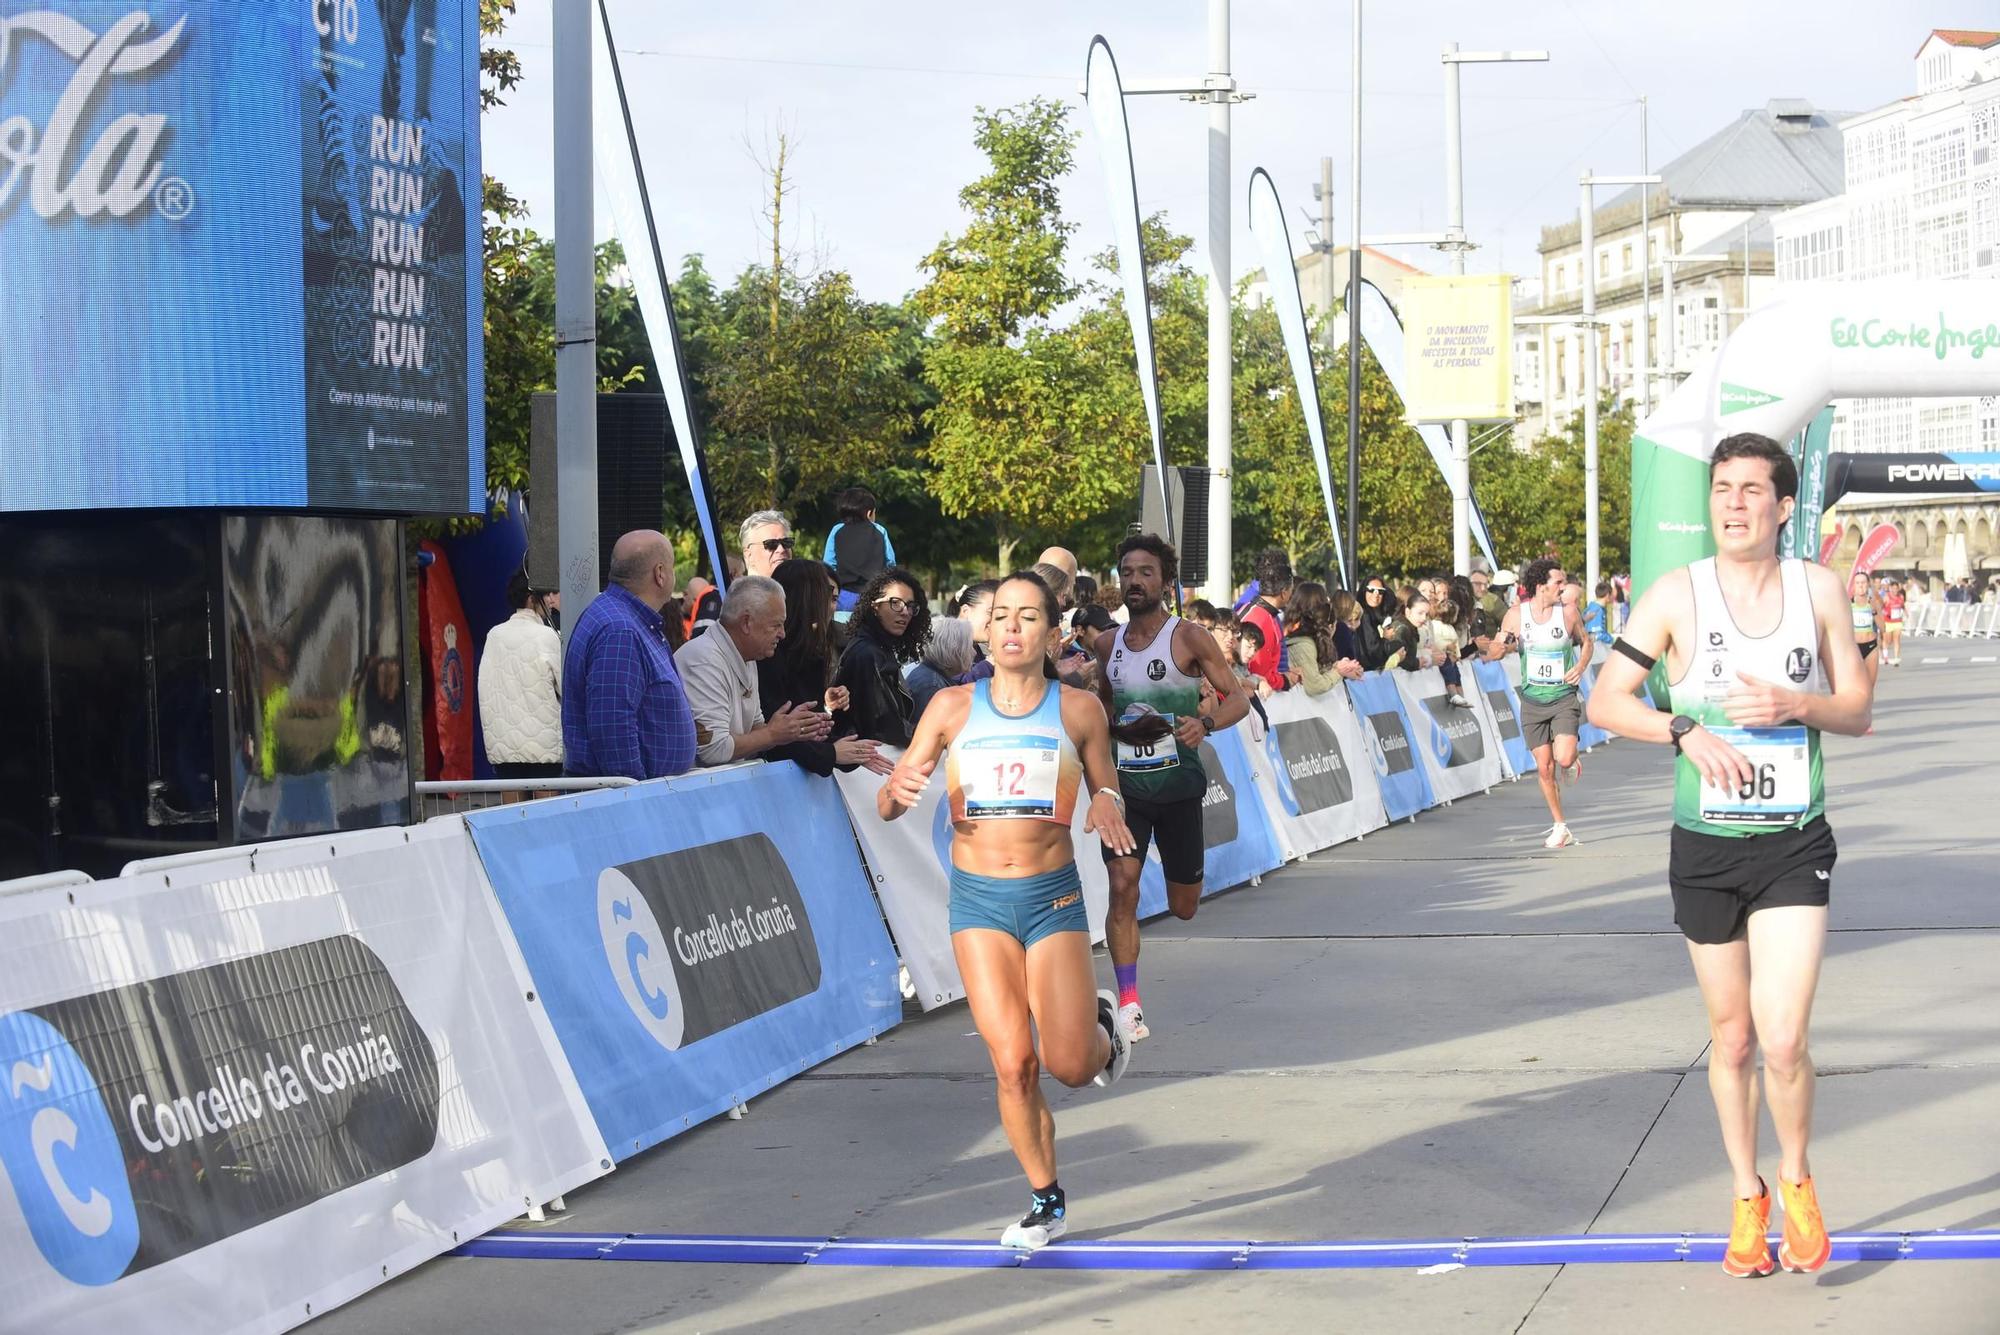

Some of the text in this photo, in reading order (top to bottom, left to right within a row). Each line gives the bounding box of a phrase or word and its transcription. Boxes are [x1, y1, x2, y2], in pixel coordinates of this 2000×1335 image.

[1435, 325, 1489, 335] MOVEMENTO
[1831, 311, 2000, 360] El Corte Ingl
[1421, 345, 1495, 357] NECESITA A TODAS
[1429, 337, 1441, 346] DA
[1446, 357, 1481, 367] PERSOAS
[1888, 463, 2000, 482] POWERA
[1538, 665, 1552, 677] 49
[1287, 750, 1341, 780] Concello da Coruña
[993, 763, 1025, 795] 12
[674, 896, 797, 966] Concello da Coruña
[130, 1023, 402, 1153] Concello da Coruña
